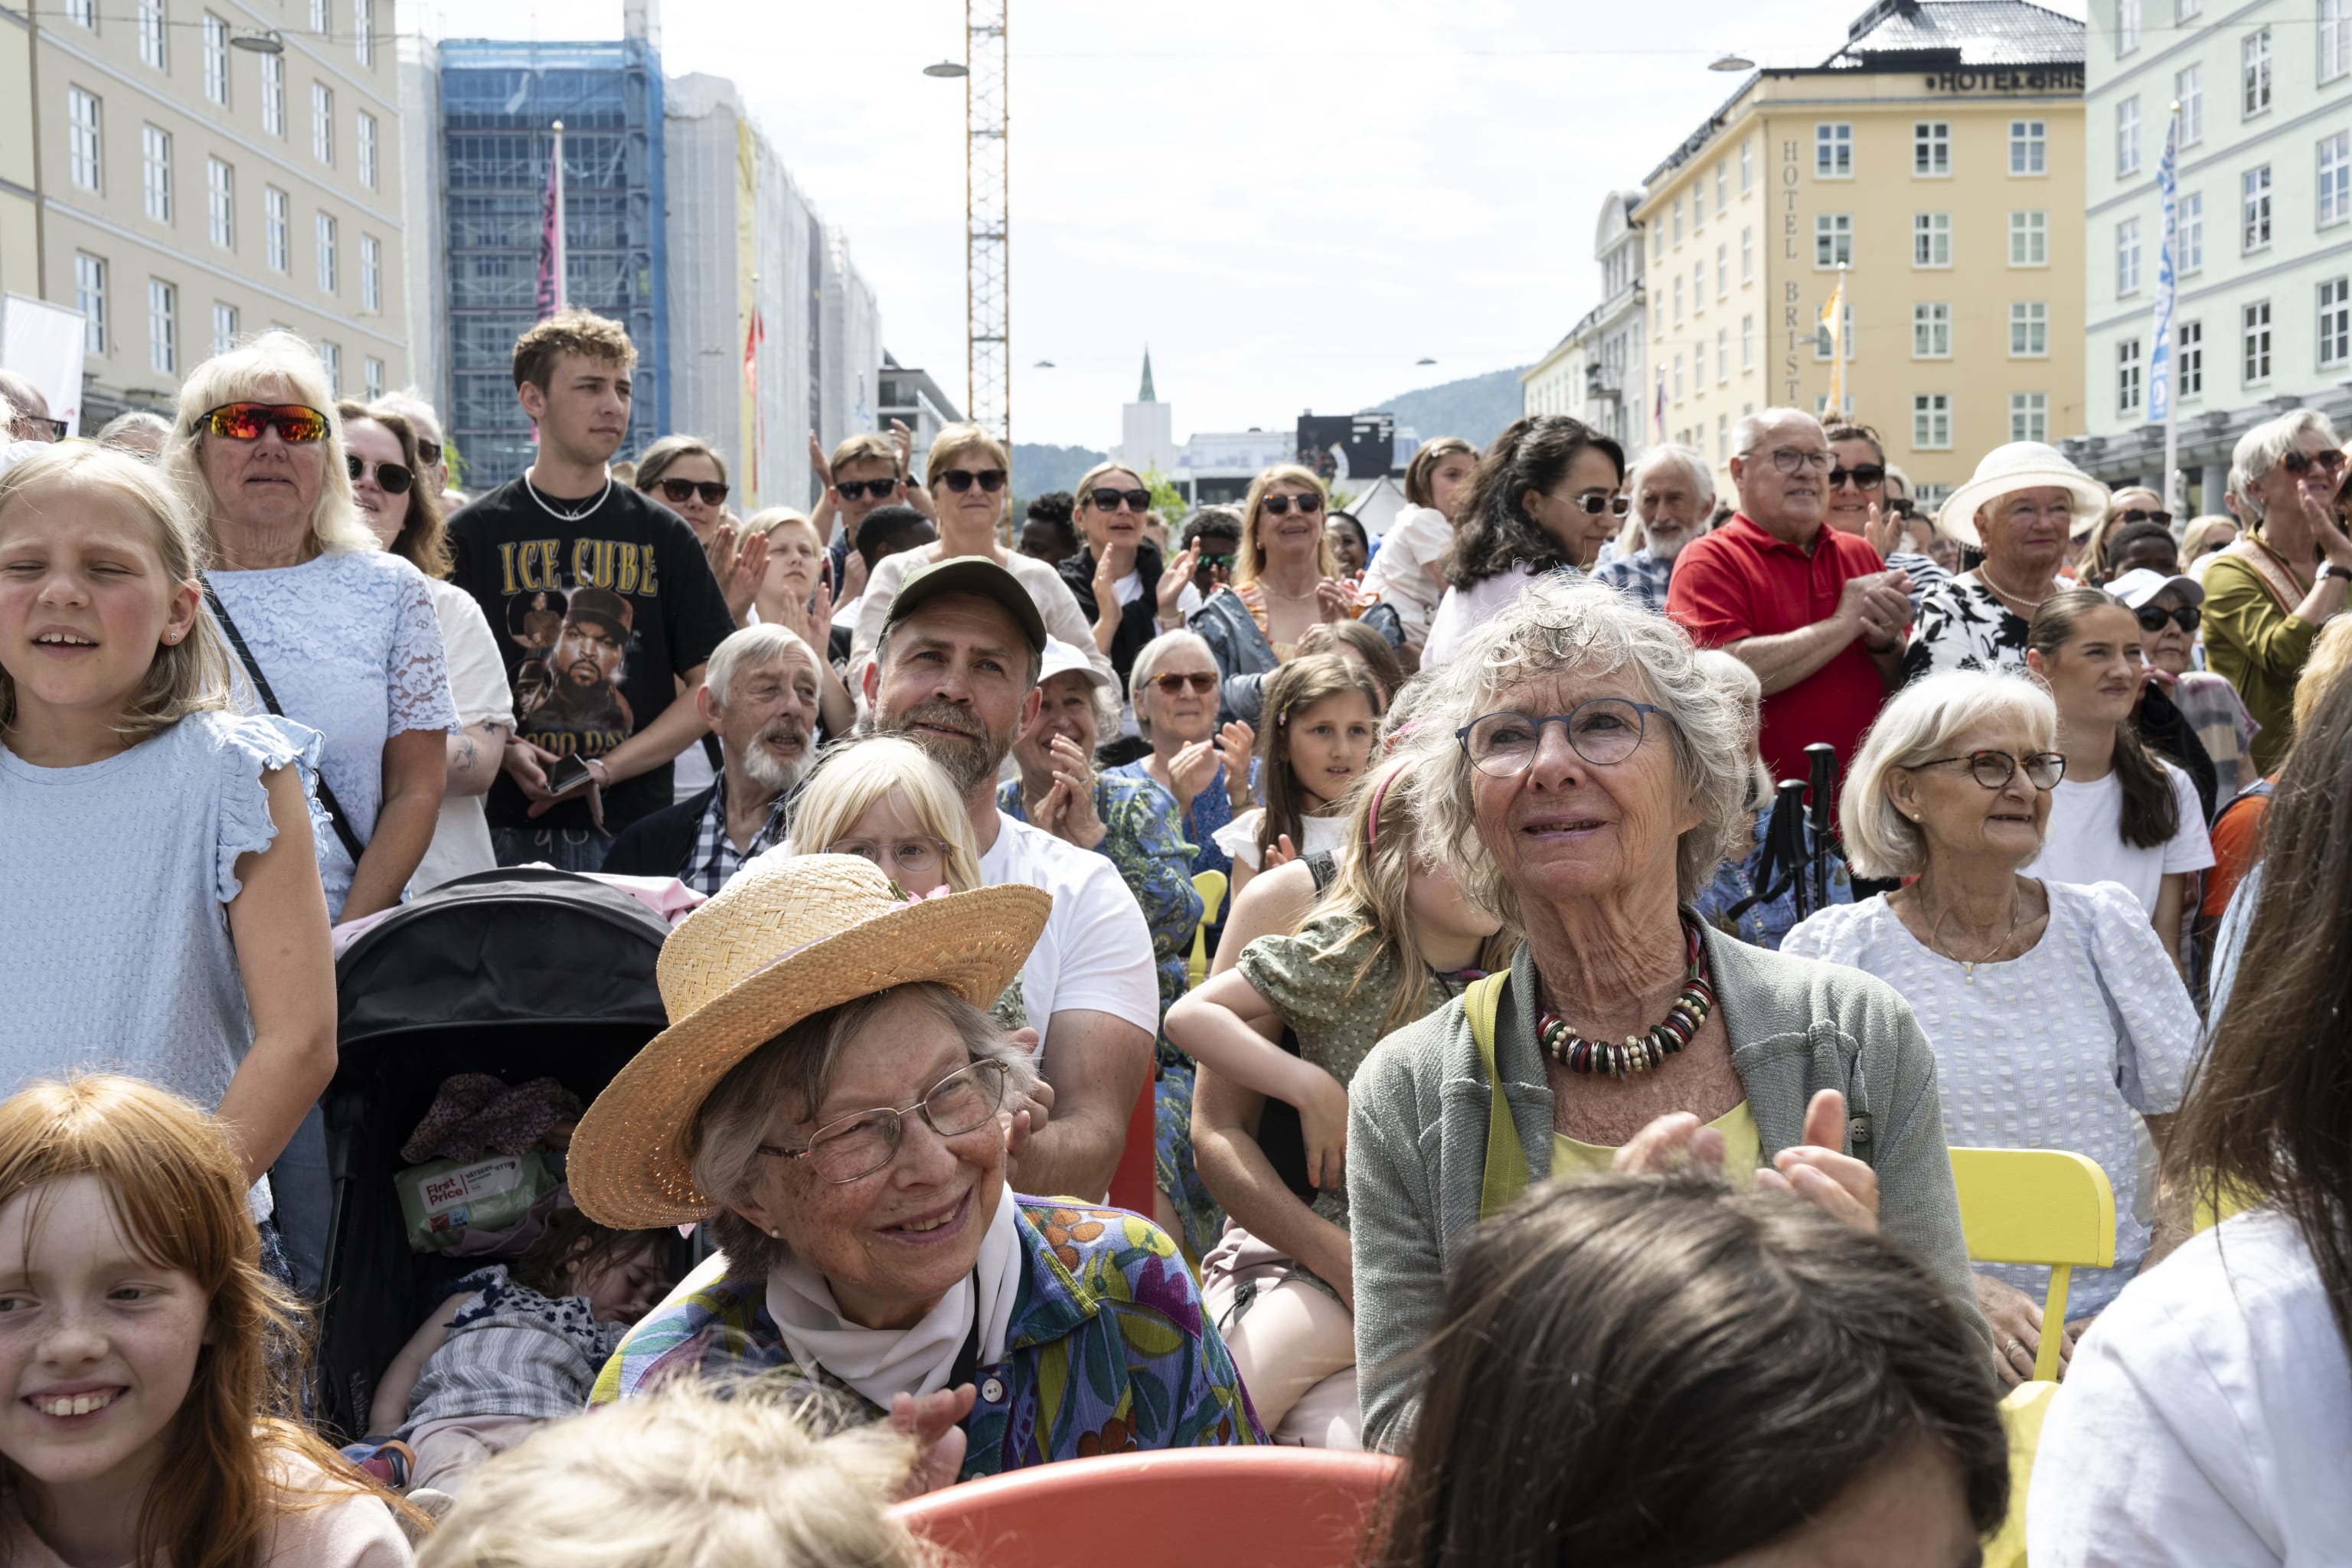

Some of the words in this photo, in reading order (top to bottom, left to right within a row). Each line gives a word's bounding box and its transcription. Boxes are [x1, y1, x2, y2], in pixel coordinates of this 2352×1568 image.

[1940, 71, 2024, 92] HOTEL
[1783, 140, 1800, 259] HOTEL
[1785, 281, 1799, 406] BRIST
[498, 538, 561, 595] ICE
[571, 537, 658, 596] CUBE
[426, 1178, 456, 1195] First
[429, 1187, 463, 1206] Price
